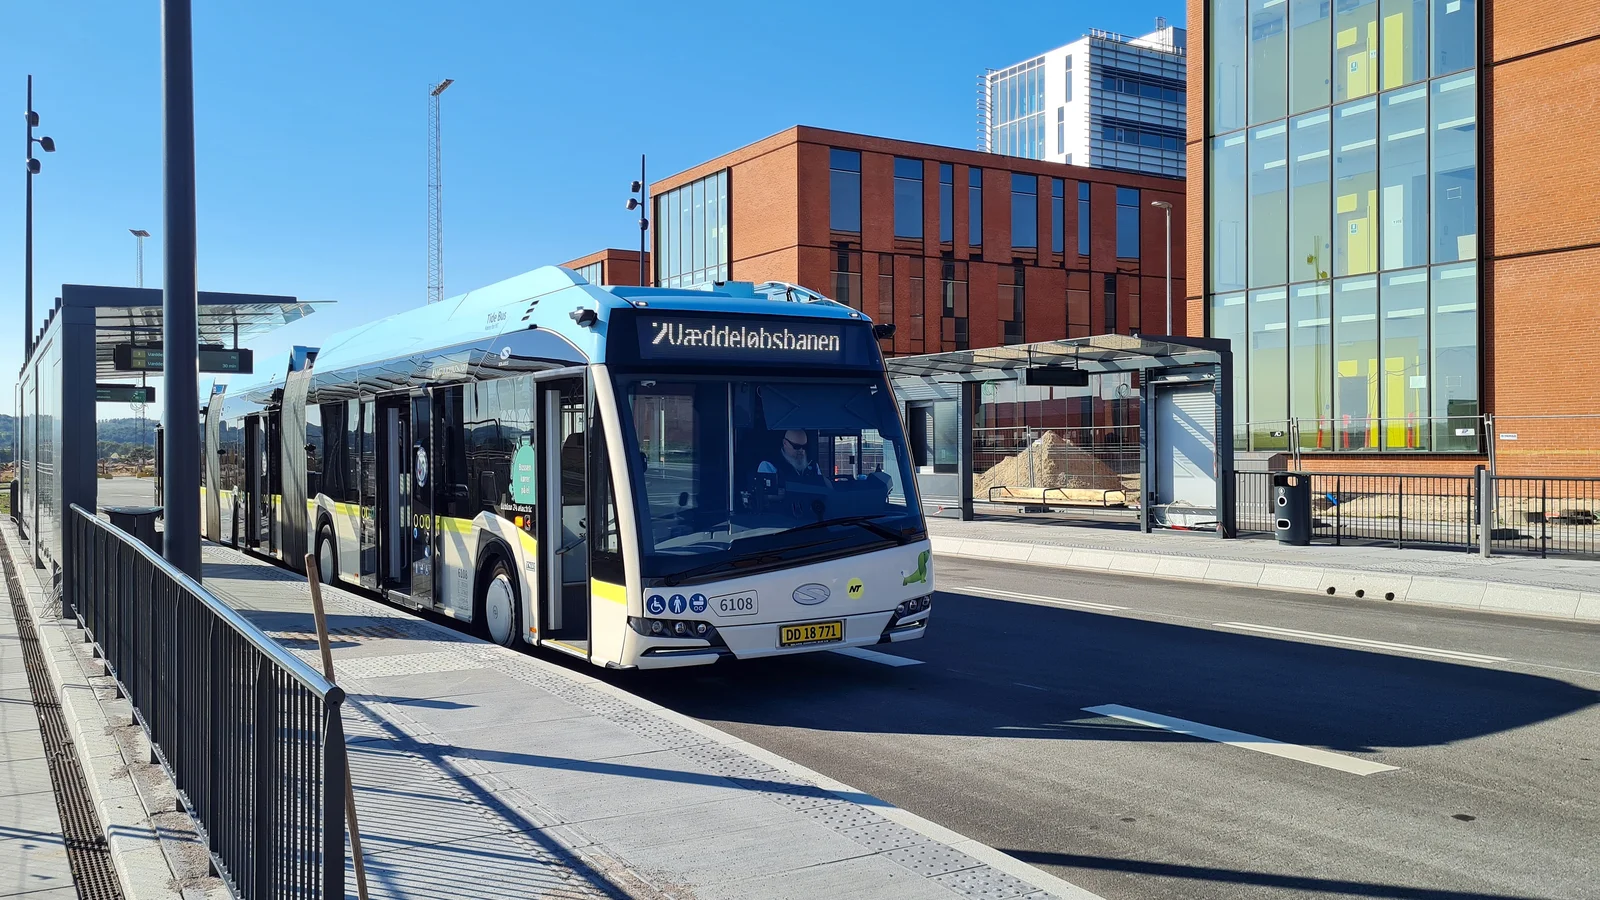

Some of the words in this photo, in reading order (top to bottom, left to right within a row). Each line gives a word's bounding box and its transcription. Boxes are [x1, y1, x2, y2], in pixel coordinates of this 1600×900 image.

[487, 313, 497, 324] Tide
[497, 311, 507, 322] Bus
[848, 584, 862, 594] NT
[720, 597, 753, 612] 6108
[786, 627, 801, 641] DD
[804, 626, 817, 640] 18
[818, 624, 837, 638] 771
